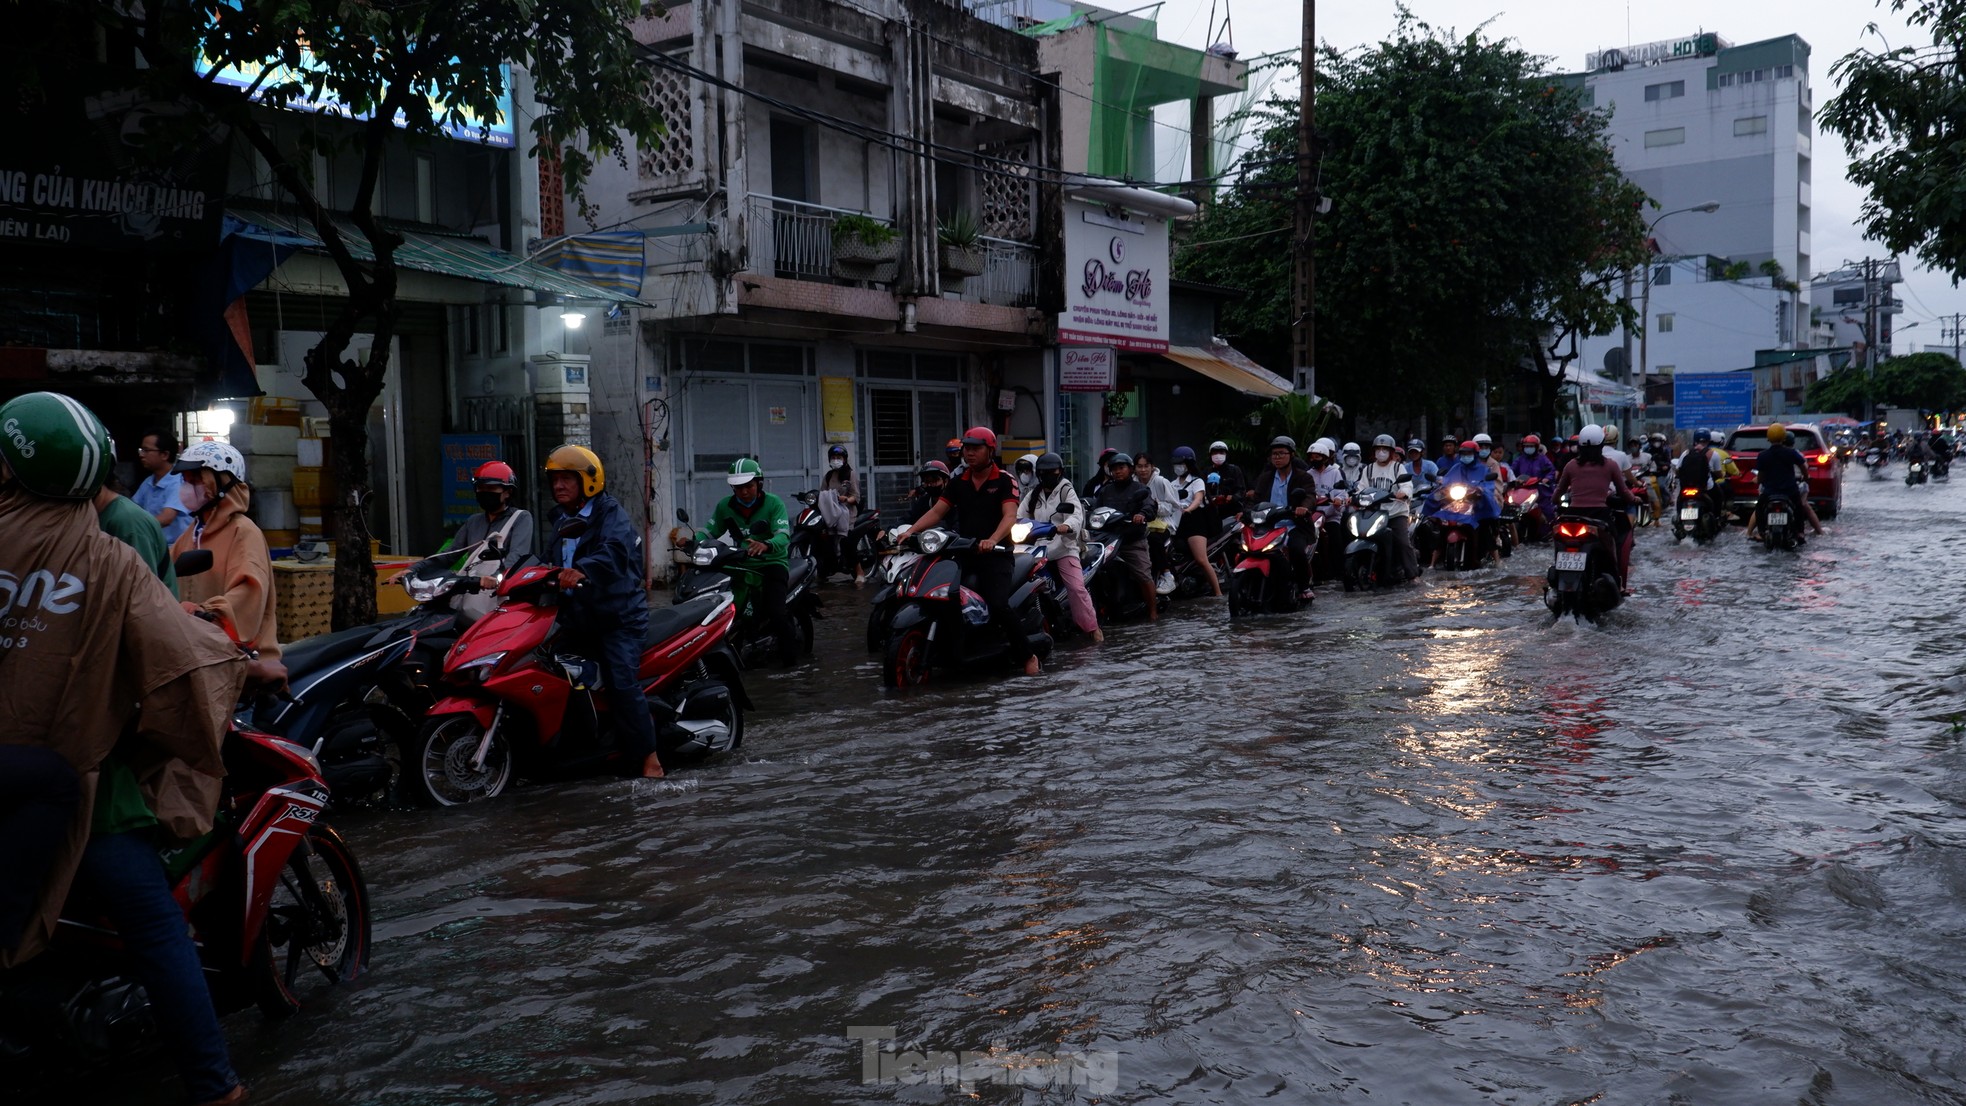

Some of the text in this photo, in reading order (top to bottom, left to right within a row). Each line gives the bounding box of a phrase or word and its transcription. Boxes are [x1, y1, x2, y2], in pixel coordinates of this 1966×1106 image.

[32, 164, 74, 208] CỦA
[81, 176, 150, 214] KHÁCH
[152, 181, 206, 220] HÀNG
[3, 418, 36, 458] Grab
[312, 789, 328, 802] 110
